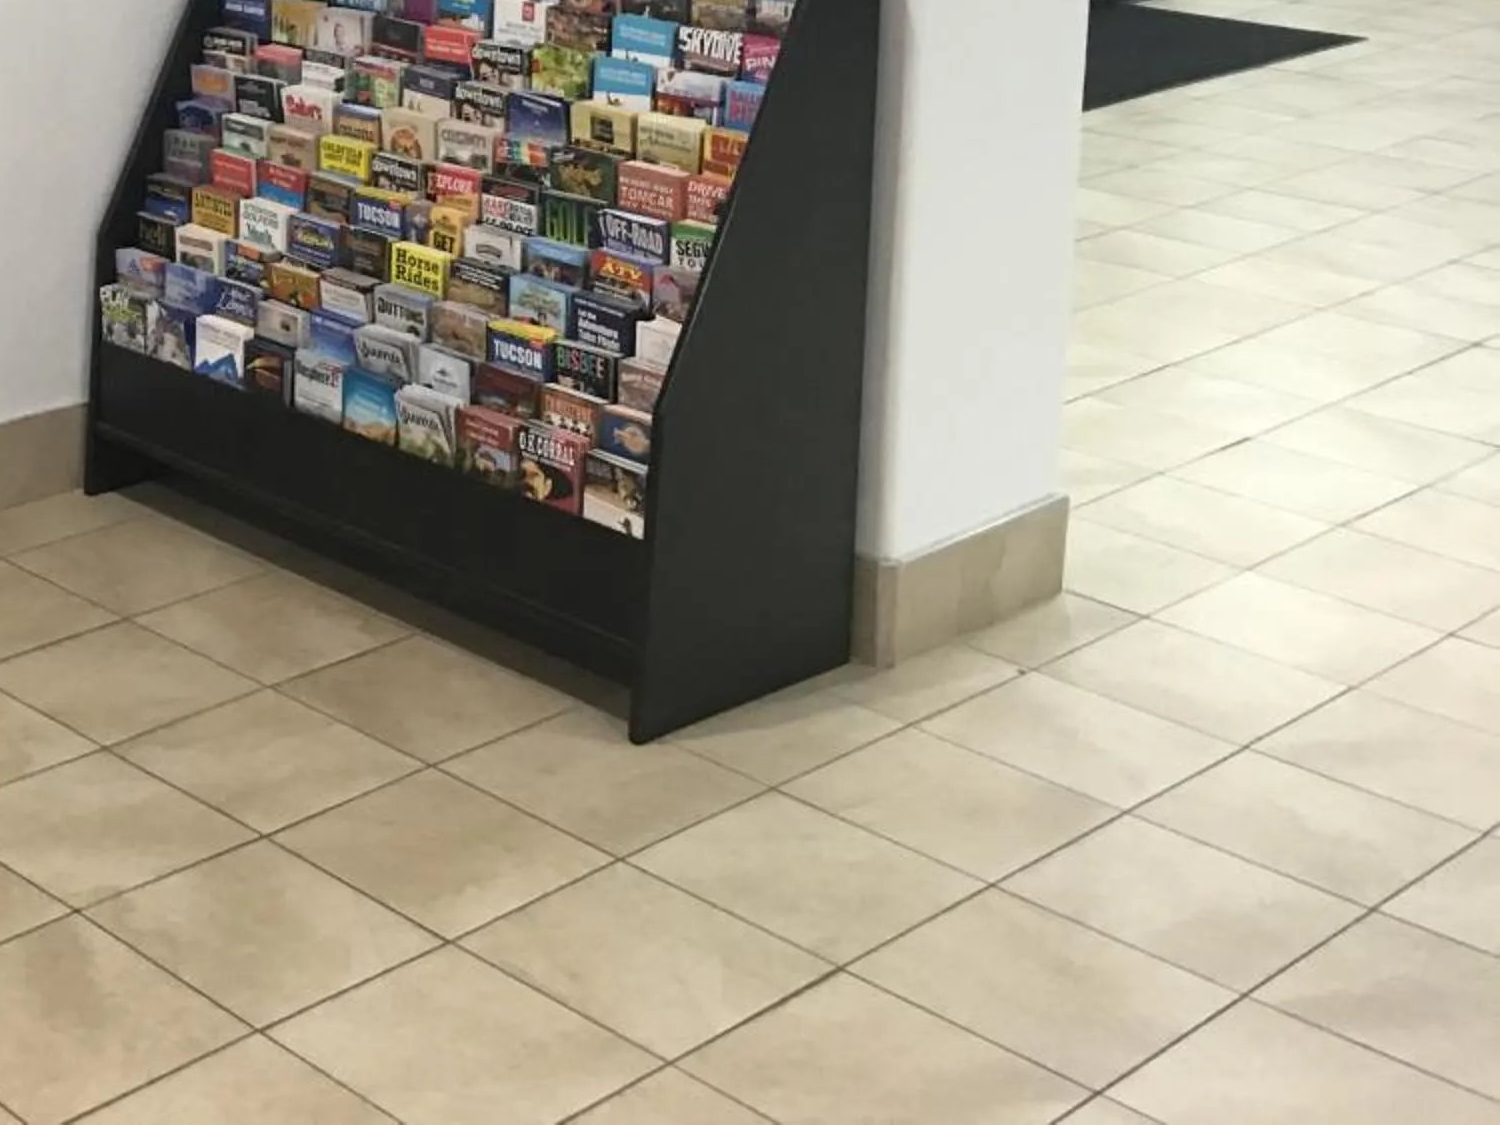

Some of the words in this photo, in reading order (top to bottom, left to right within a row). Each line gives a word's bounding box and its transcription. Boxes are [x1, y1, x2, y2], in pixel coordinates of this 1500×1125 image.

[678, 26, 743, 66] SKYDIVE
[357, 202, 400, 225] TUCSON
[433, 230, 455, 253] GET
[675, 238, 711, 258] SEGW
[395, 248, 440, 273] Horse
[395, 264, 440, 291] Rides
[493, 338, 543, 370] TUCSON
[556, 344, 606, 379] BISBEE
